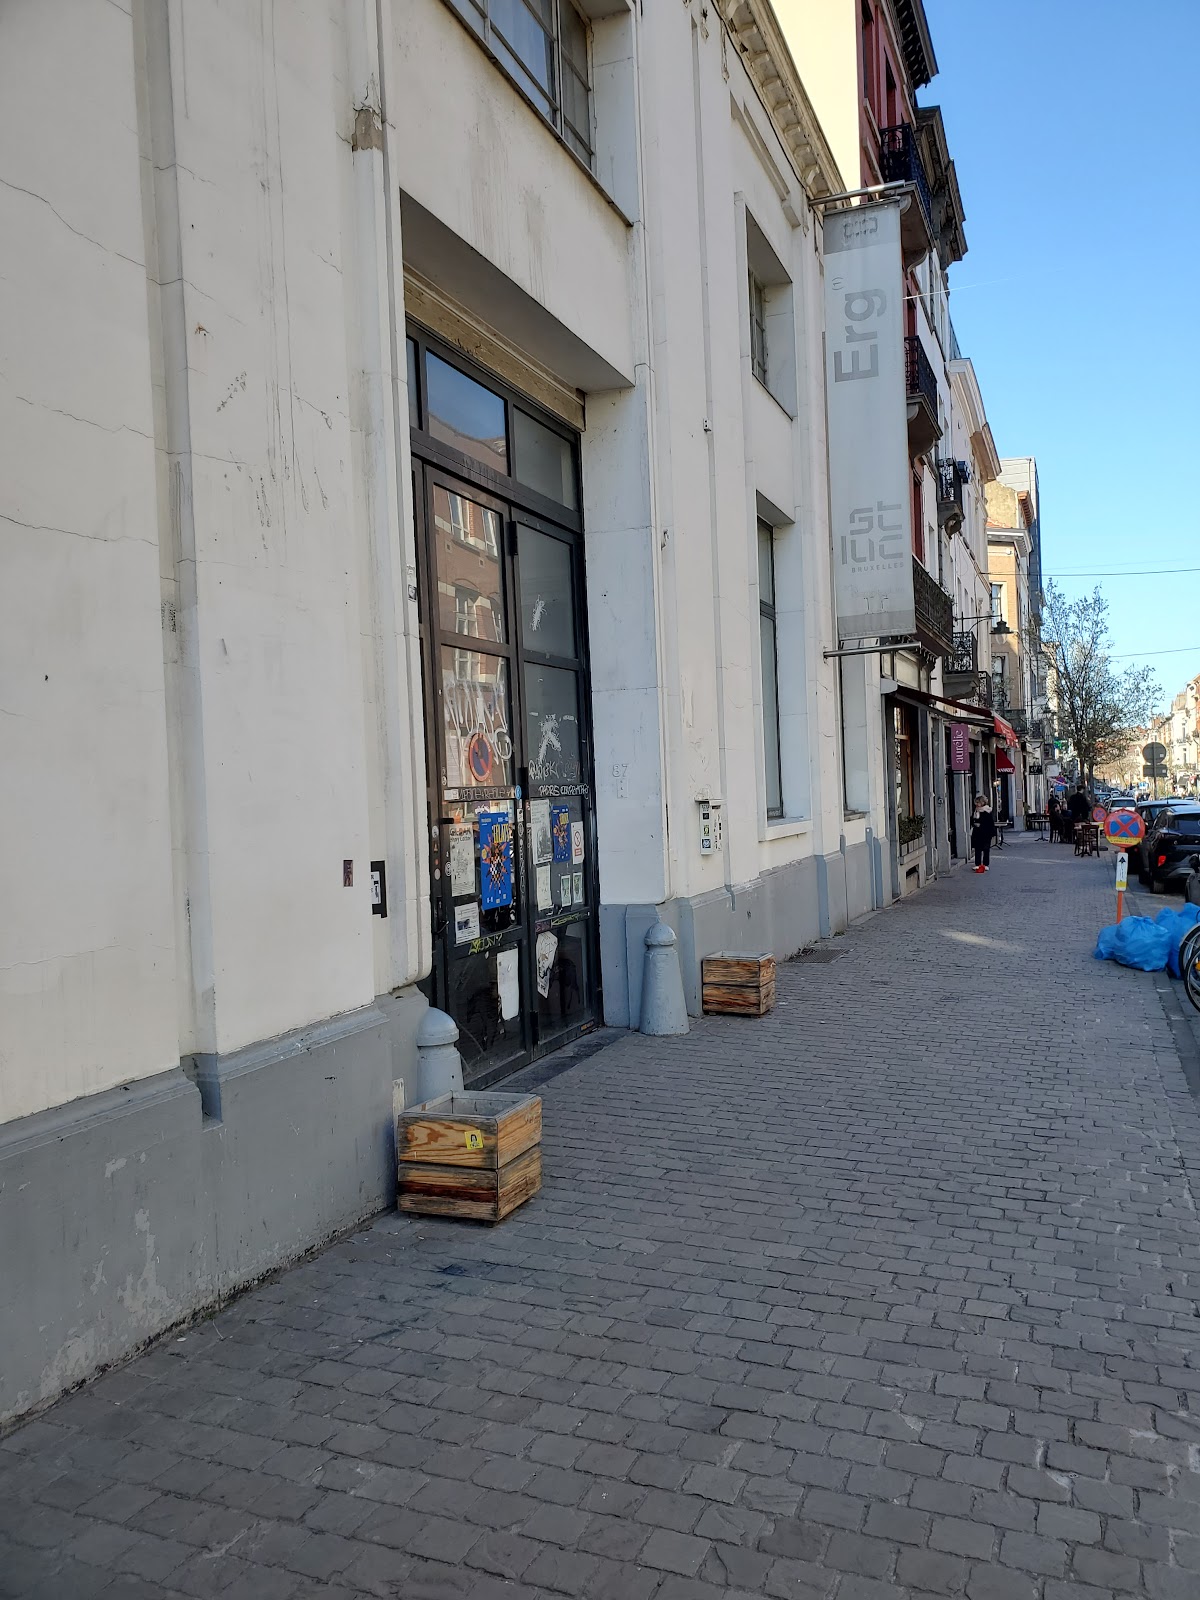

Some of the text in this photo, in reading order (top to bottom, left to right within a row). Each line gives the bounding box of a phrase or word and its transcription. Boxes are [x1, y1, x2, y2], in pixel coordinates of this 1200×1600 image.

[834, 288, 887, 383] Erg
[851, 561, 905, 573] BRUXELLES
[952, 730, 964, 764] aurélie
[612, 764, 629, 777] 87
